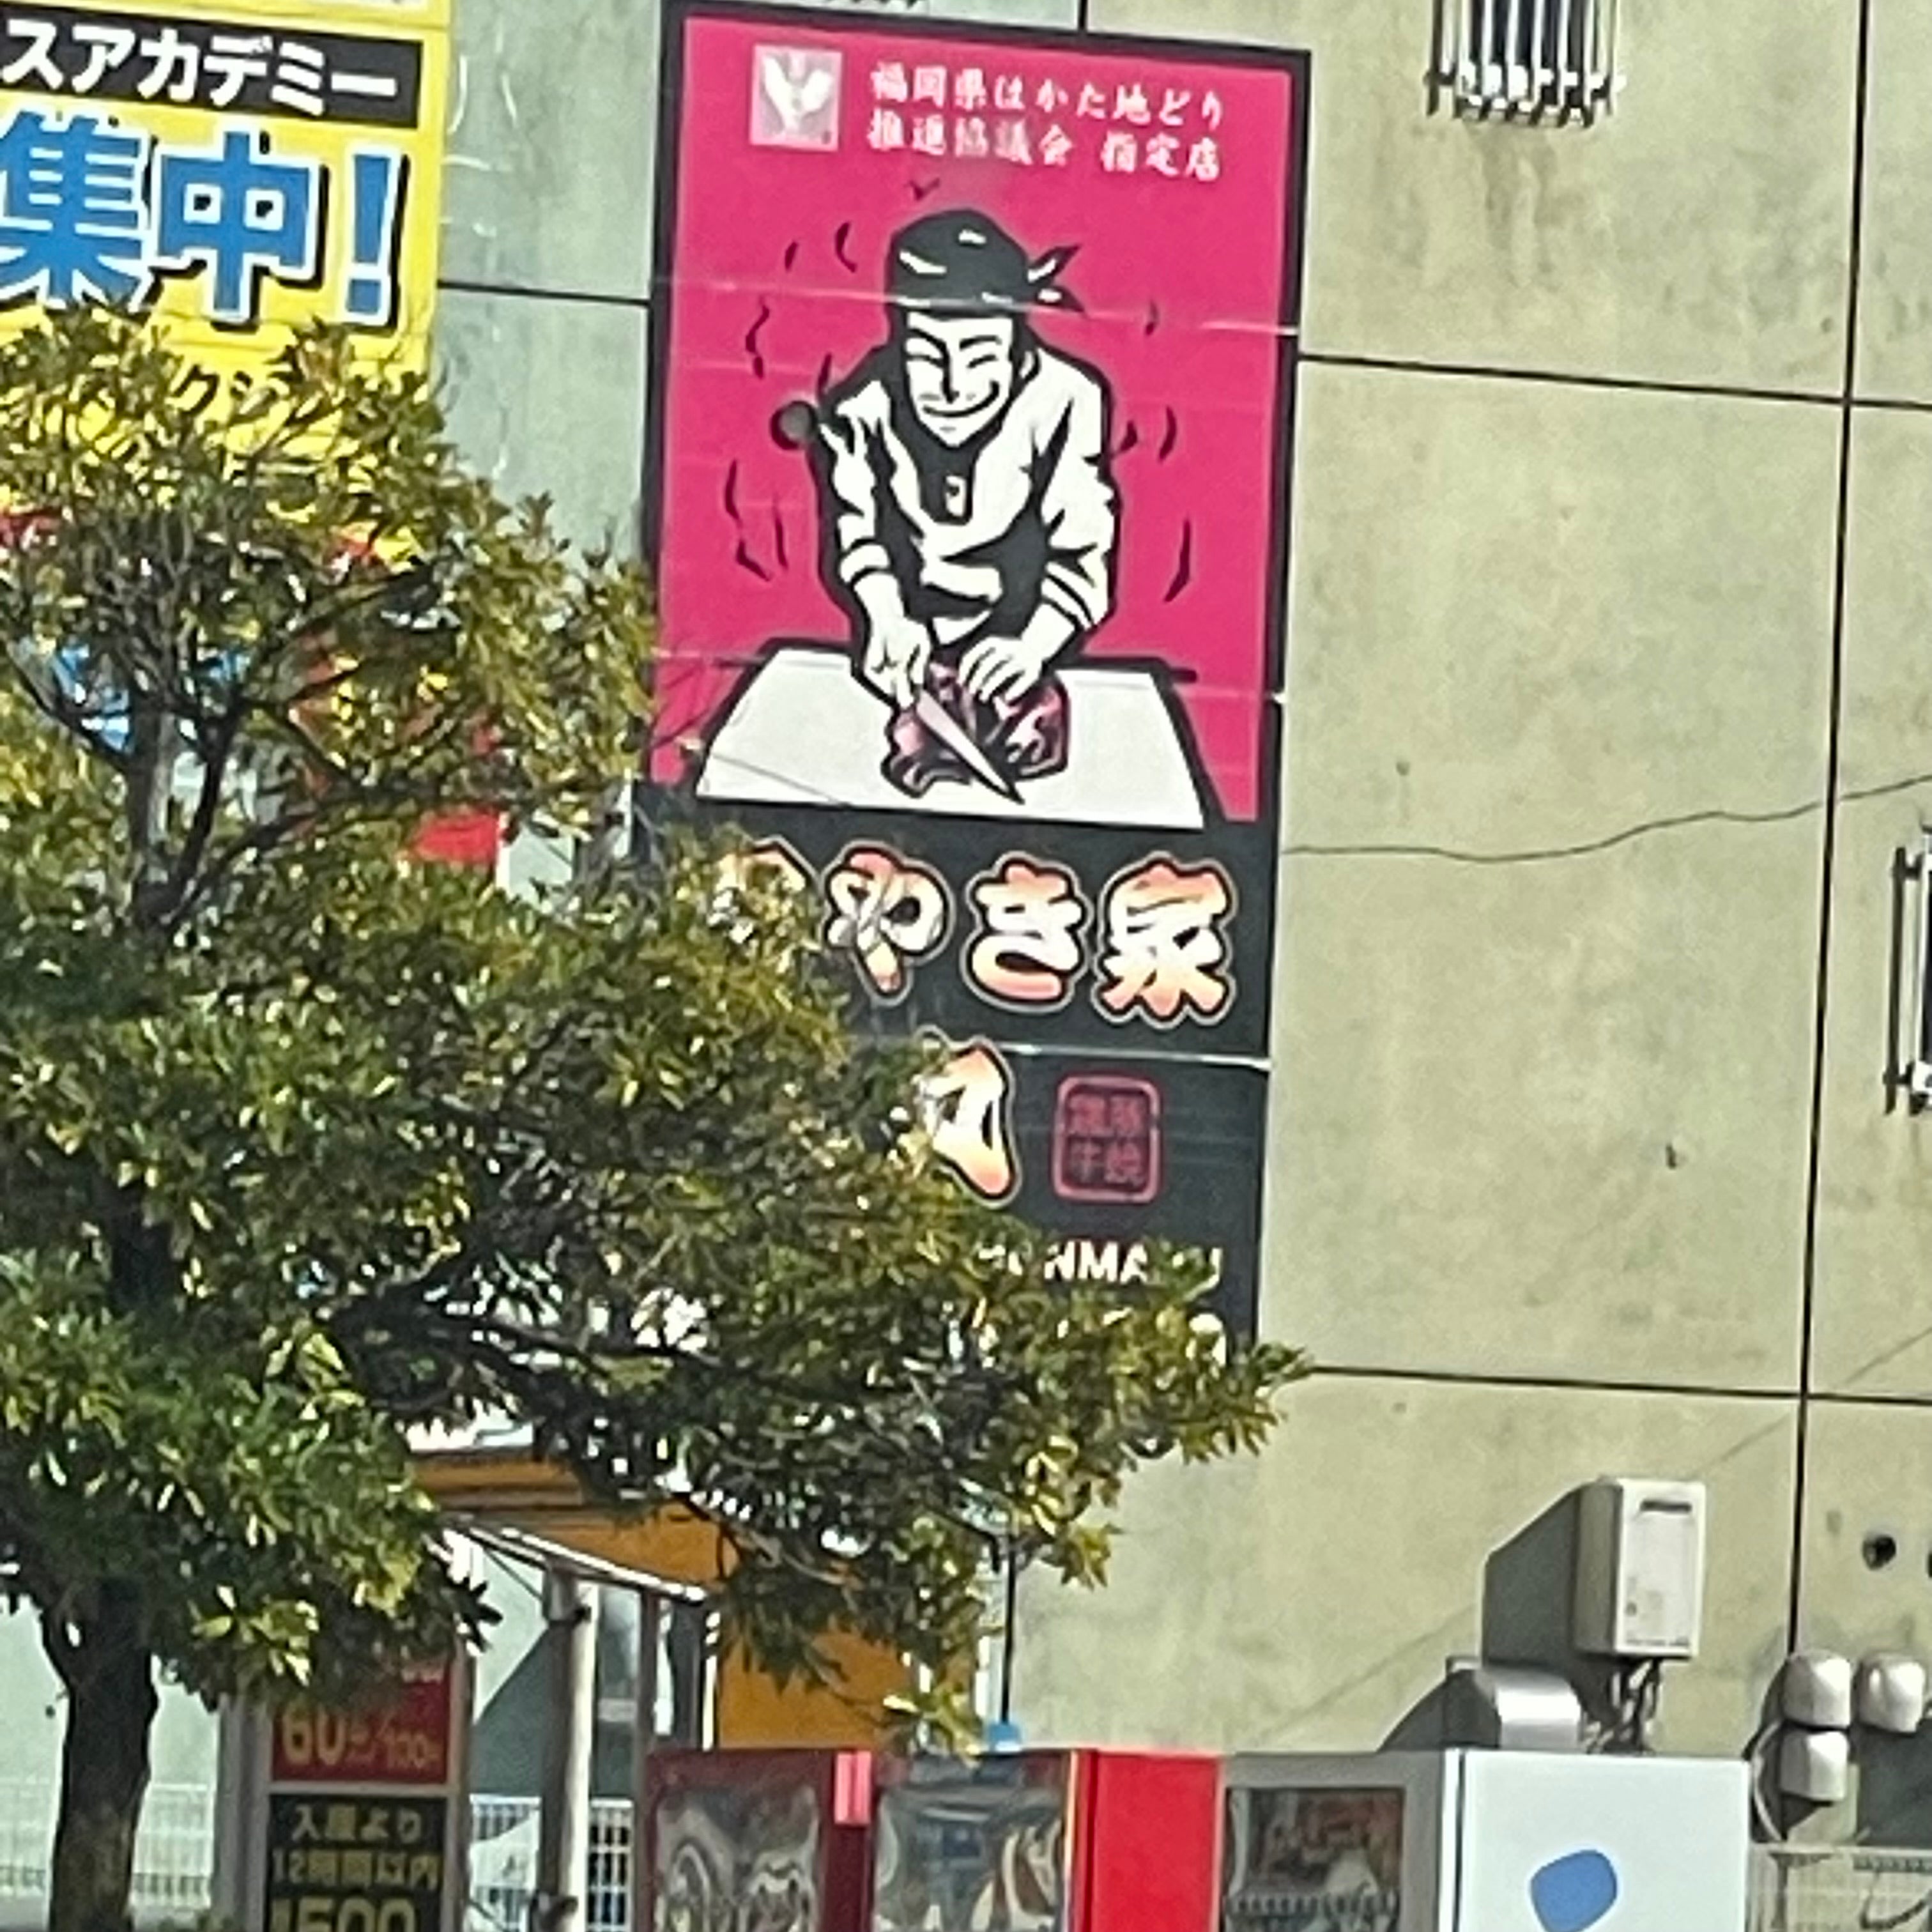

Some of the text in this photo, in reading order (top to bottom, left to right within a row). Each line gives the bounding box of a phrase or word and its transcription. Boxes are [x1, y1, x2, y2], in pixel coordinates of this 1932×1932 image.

[3, 18, 397, 116] スアカデミー
[871, 62, 1223, 131] 福岡県はかた地どり
[867, 107, 1221, 182] 推進協議会 指定店
